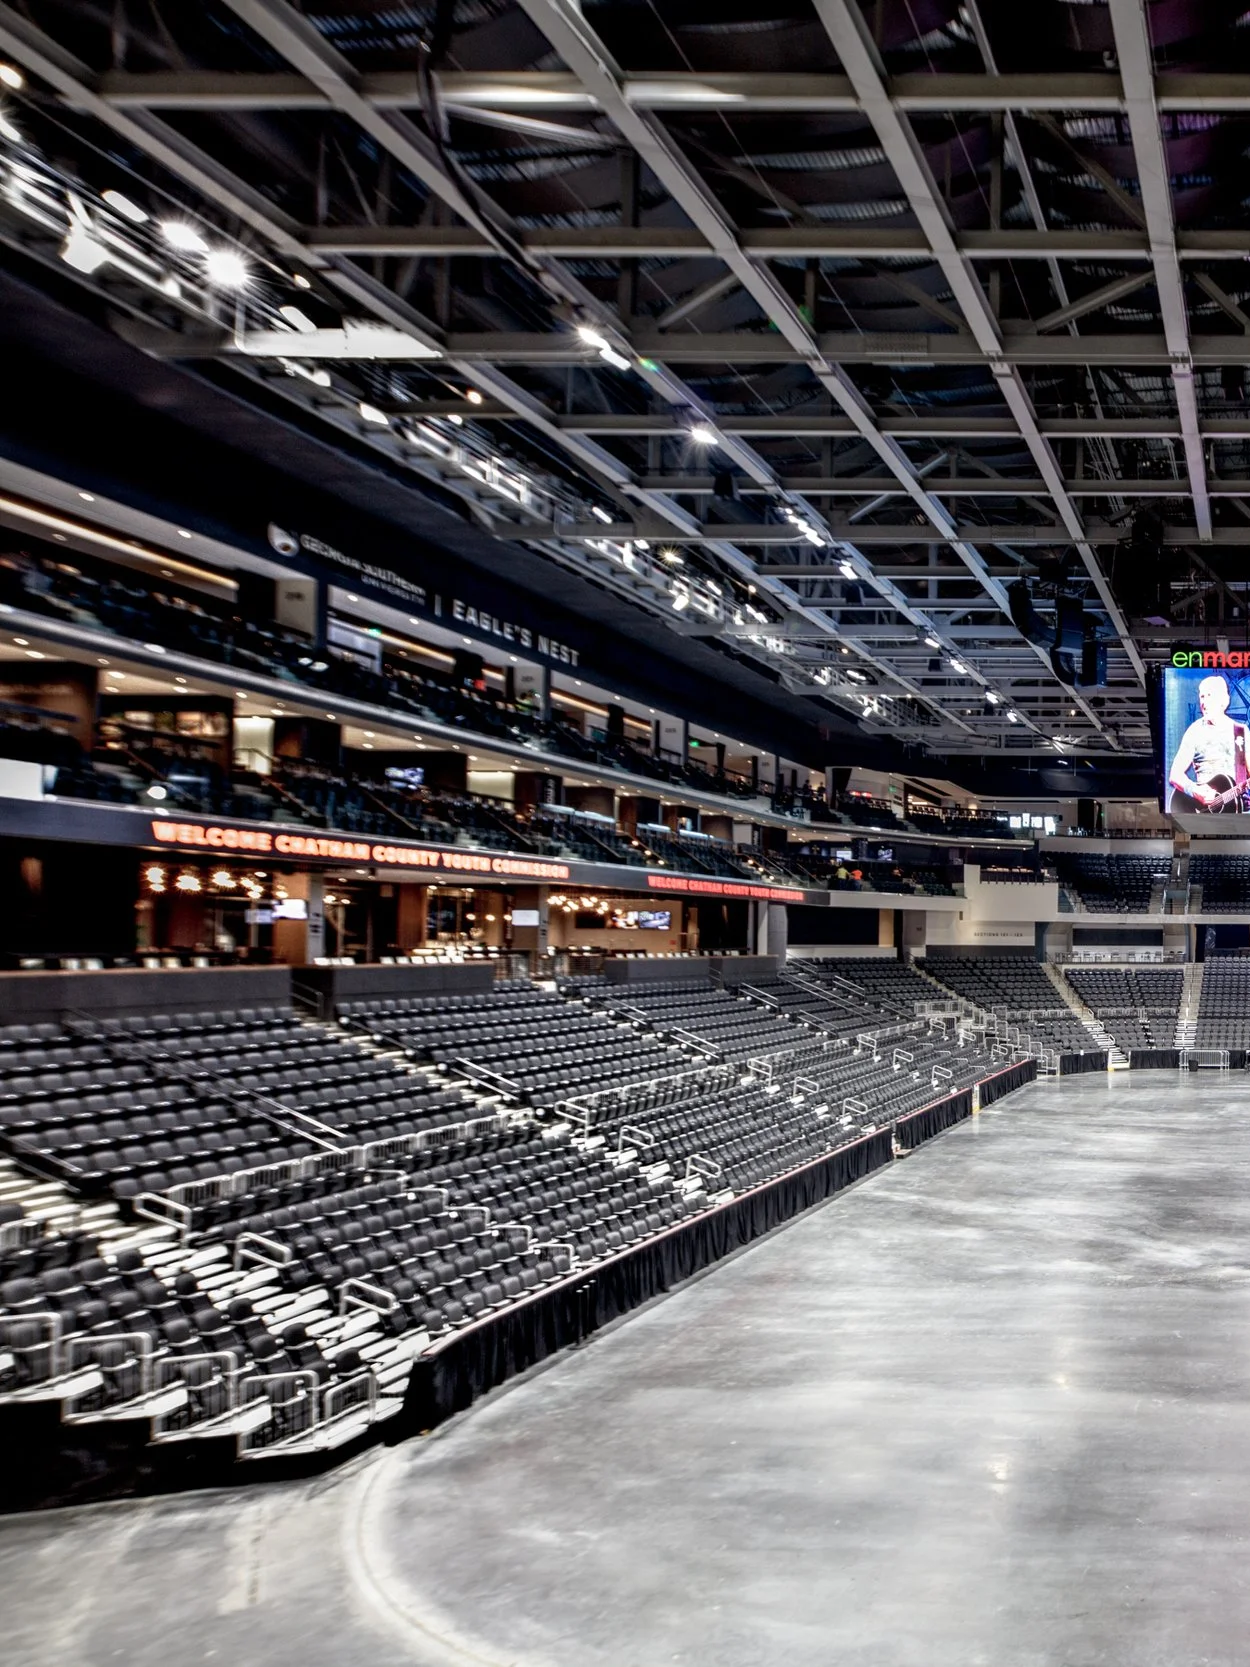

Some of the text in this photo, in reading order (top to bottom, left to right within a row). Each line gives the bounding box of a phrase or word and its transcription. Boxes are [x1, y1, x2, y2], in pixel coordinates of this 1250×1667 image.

[452, 598, 580, 667] EAGLE'S NEST
[151, 821, 569, 879] WELCOME CHATHAM COUNTY YOUTH COMMISSION
